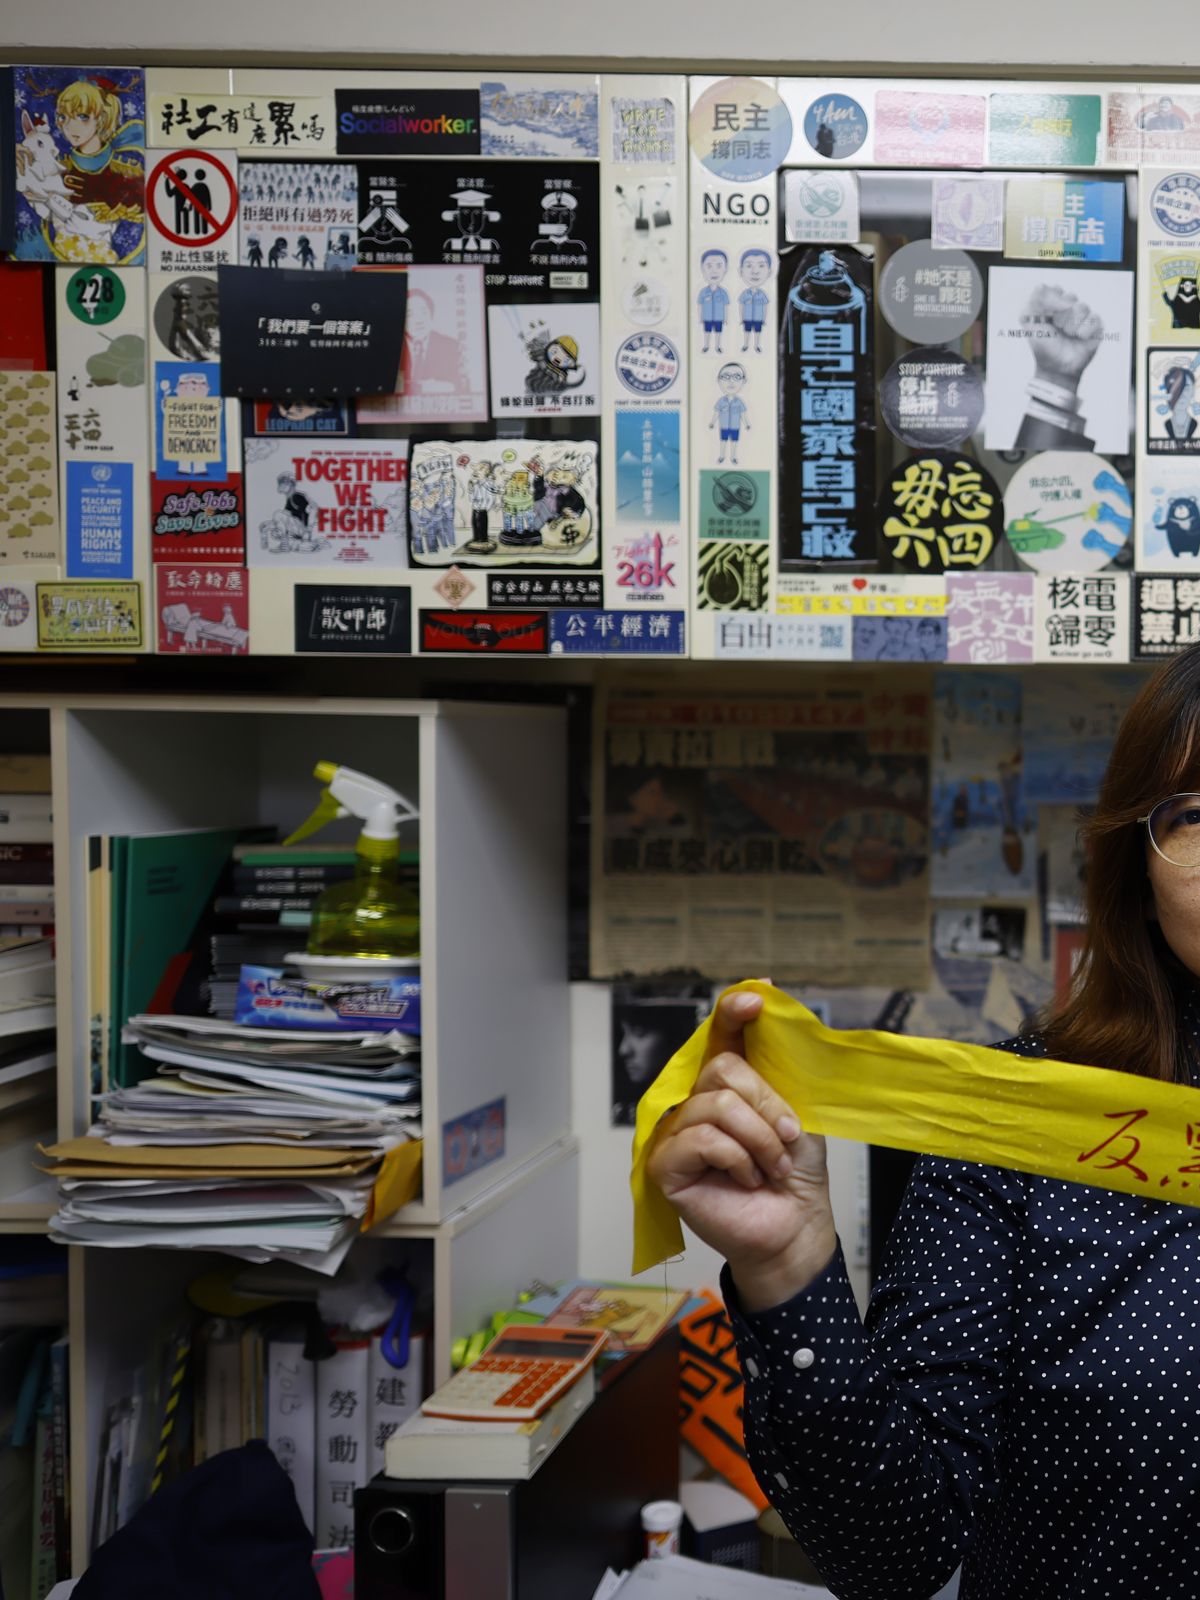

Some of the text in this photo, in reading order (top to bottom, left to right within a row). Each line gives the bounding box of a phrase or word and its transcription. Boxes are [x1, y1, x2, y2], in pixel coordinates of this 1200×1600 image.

[340, 112, 477, 134] Socialworker.
[712, 103, 771, 131] 民主
[703, 192, 770, 216] NGO
[160, 264, 174, 272] NO
[76, 278, 114, 303] 228
[899, 378, 938, 396] 停止
[168, 415, 217, 428] FREEDOM
[266, 418, 337, 432] LEOPARD CAT
[168, 438, 217, 454] DEMOCRACY
[292, 458, 408, 482] TOGETHER
[165, 491, 237, 516] Safe Jobs
[334, 484, 372, 506] WE
[155, 511, 239, 533] Save Lives
[317, 508, 388, 532] FIGHT
[81, 528, 122, 539] HUMAN
[81, 538, 122, 551] RIGHTS
[883, 513, 994, 567] 六四
[166, 570, 243, 591] 致命粉塵
[1049, 577, 1116, 611] 核電
[566, 614, 672, 638] 公平經濟
[1047, 614, 1116, 648] 歸零
